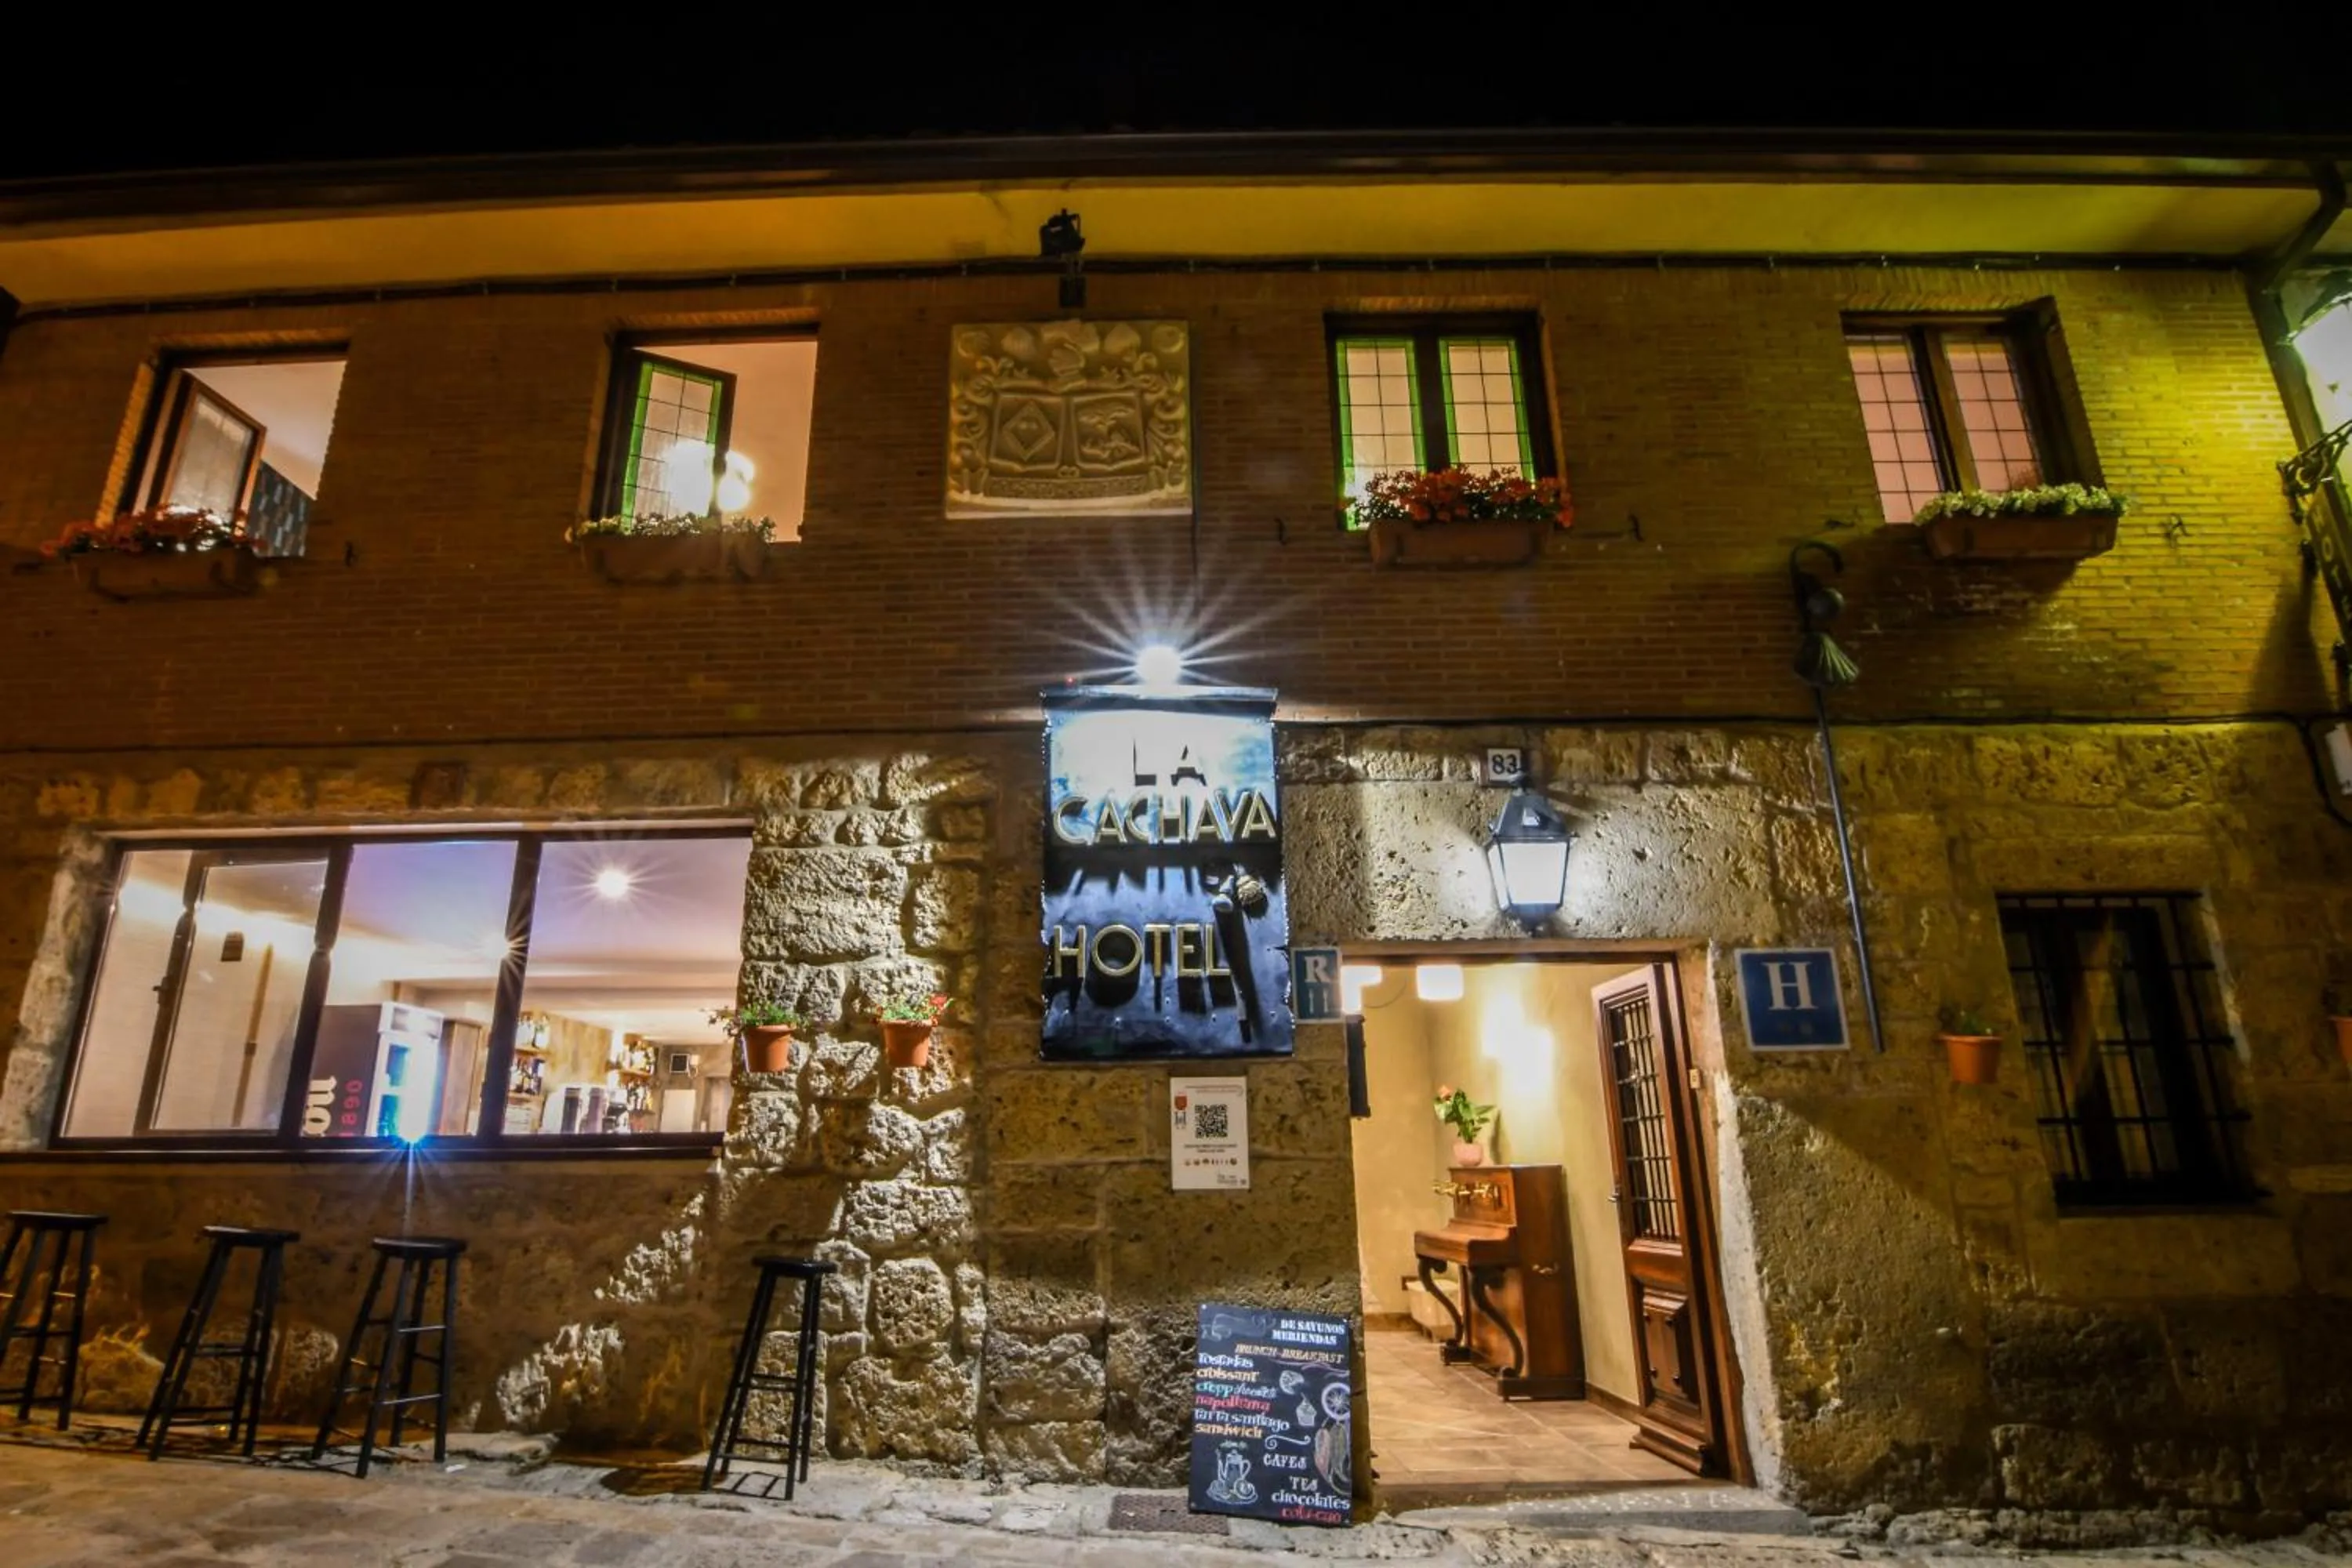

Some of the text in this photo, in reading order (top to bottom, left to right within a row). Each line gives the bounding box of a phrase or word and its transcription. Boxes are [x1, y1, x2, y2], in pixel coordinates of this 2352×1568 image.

[1131, 734, 1207, 787] LA
[1492, 753, 1519, 775] 83
[1053, 788, 1277, 844] CACHAVA
[1054, 924, 1231, 978] HOTEL
[1304, 956, 1332, 983] R
[1762, 961, 1819, 1011] H
